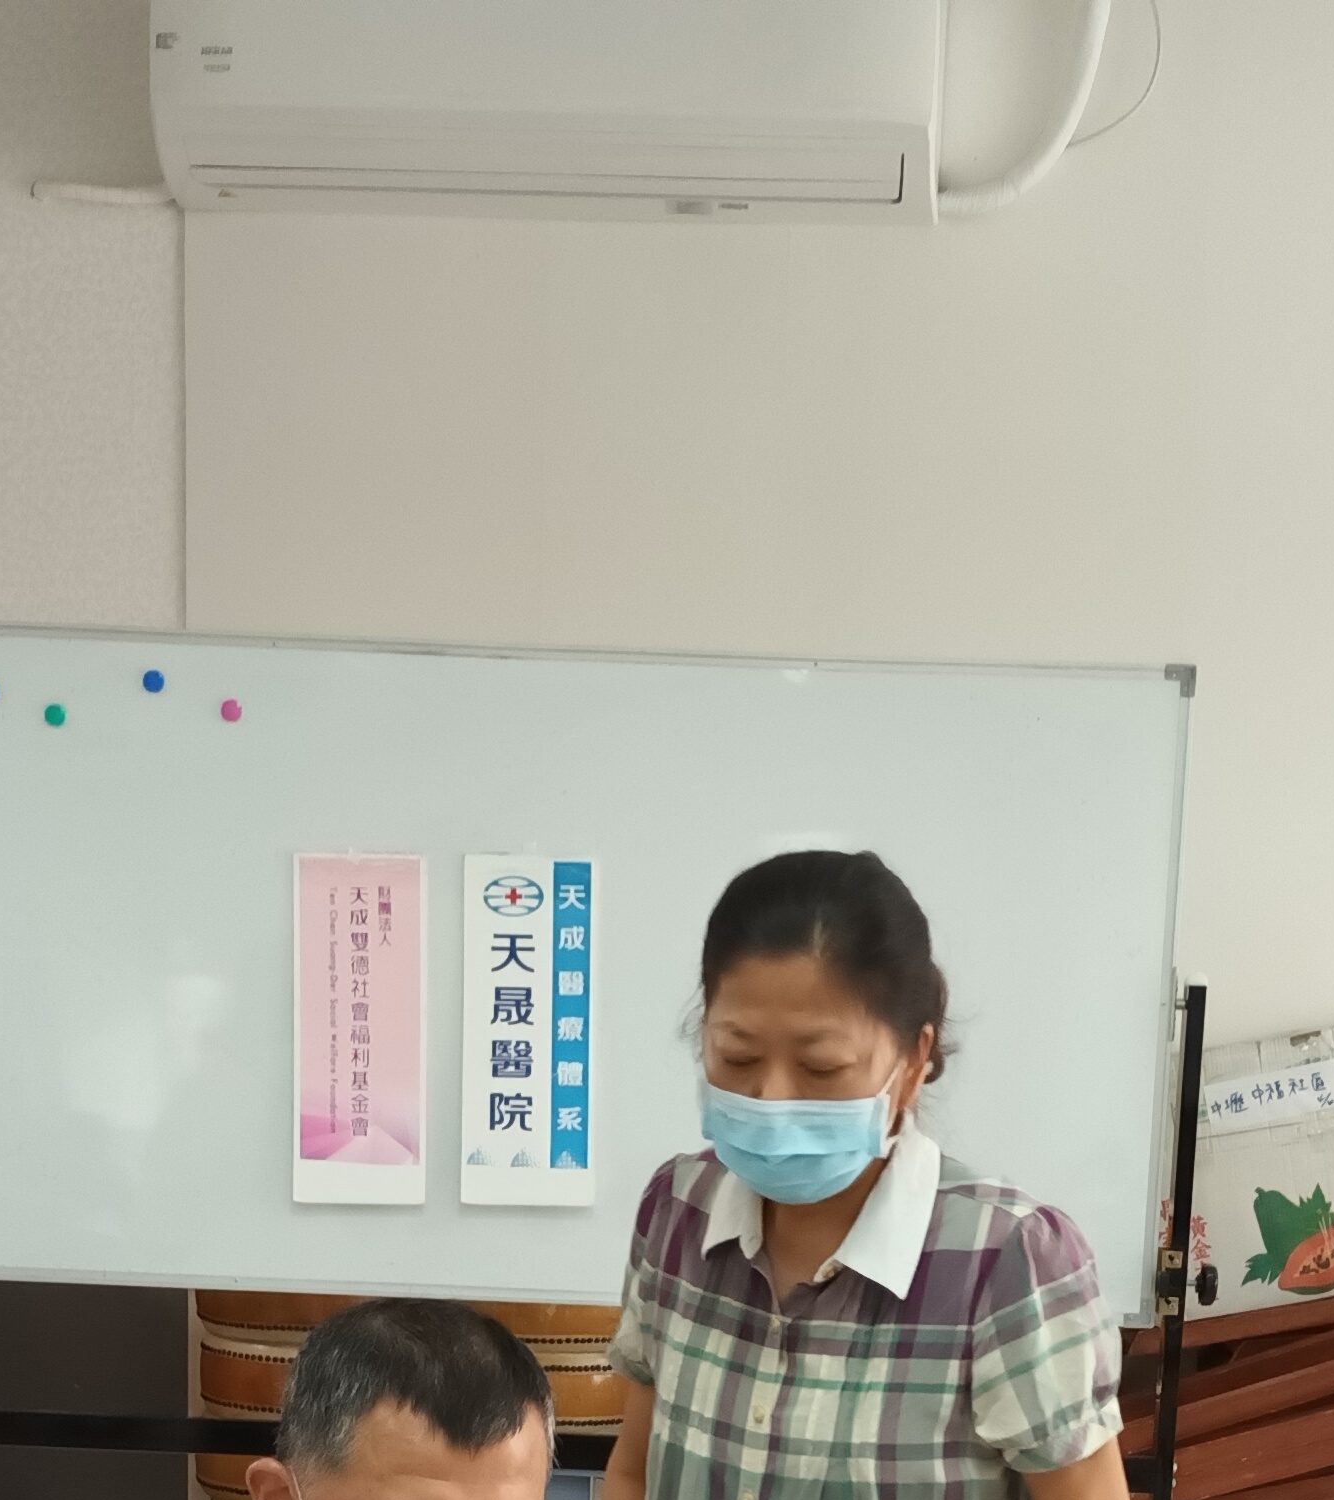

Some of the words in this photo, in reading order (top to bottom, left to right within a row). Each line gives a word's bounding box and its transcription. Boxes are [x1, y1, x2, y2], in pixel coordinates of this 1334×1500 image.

[350, 886, 370, 1137] 天成雙德社會福利基金會
[378, 886, 392, 947] 財團法人
[557, 884, 586, 1132] 天成醫療體系
[488, 933, 536, 1132] 天晟醫院
[1191, 1214, 1213, 1274] 黃金
